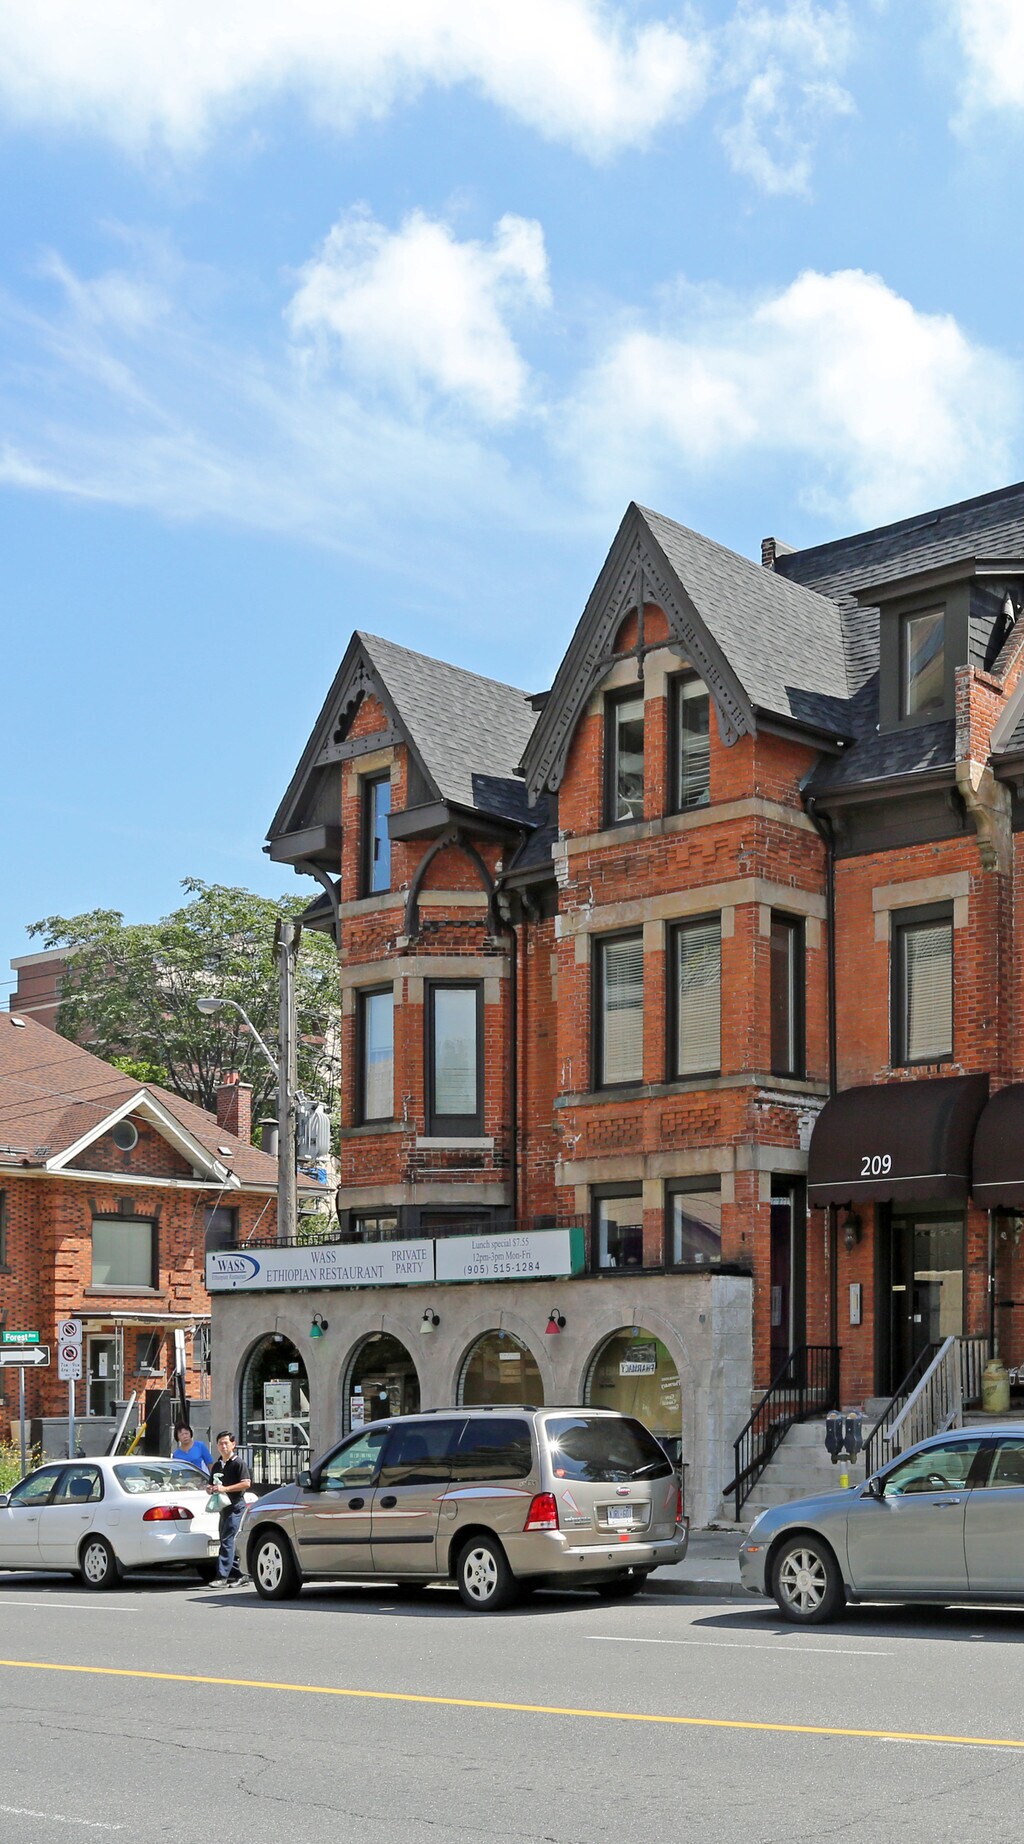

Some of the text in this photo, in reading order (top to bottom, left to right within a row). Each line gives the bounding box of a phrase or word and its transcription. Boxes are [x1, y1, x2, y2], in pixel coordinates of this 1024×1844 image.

[860, 1154, 892, 1176] 209
[471, 1240, 490, 1250] Lunch
[491, 1238, 511, 1250] special
[311, 1251, 337, 1263] WASS
[391, 1249, 428, 1261] PRIVATE
[472, 1250, 531, 1263] 12pm-3pm Mon-Fri
[218, 1259, 246, 1272] WASS
[395, 1262, 425, 1274] PARTY
[463, 1261, 541, 1276] (905) 515-1284
[266, 1265, 385, 1283] ETHIOPIAN RESTAURANT
[5, 1333, 28, 1342] Forest
